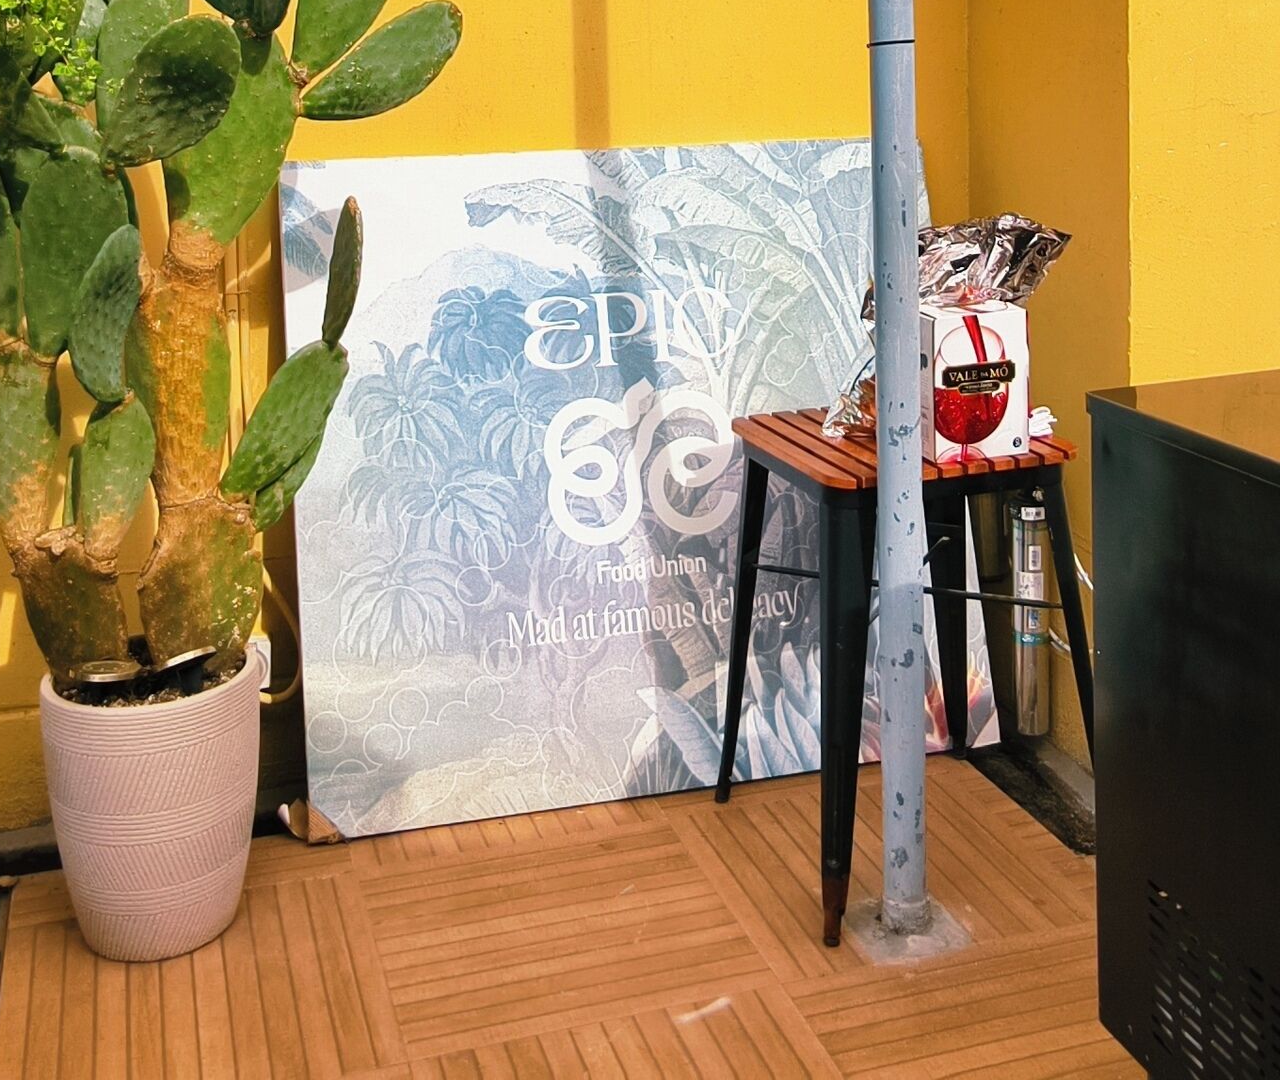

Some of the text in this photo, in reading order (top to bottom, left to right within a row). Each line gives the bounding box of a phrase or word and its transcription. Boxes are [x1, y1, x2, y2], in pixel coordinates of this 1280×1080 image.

[523, 287, 735, 370] EPIC
[949, 370, 978, 382] VALE
[596, 554, 707, 585] Food Union
[506, 580, 803, 648] Mad at famous delacy
